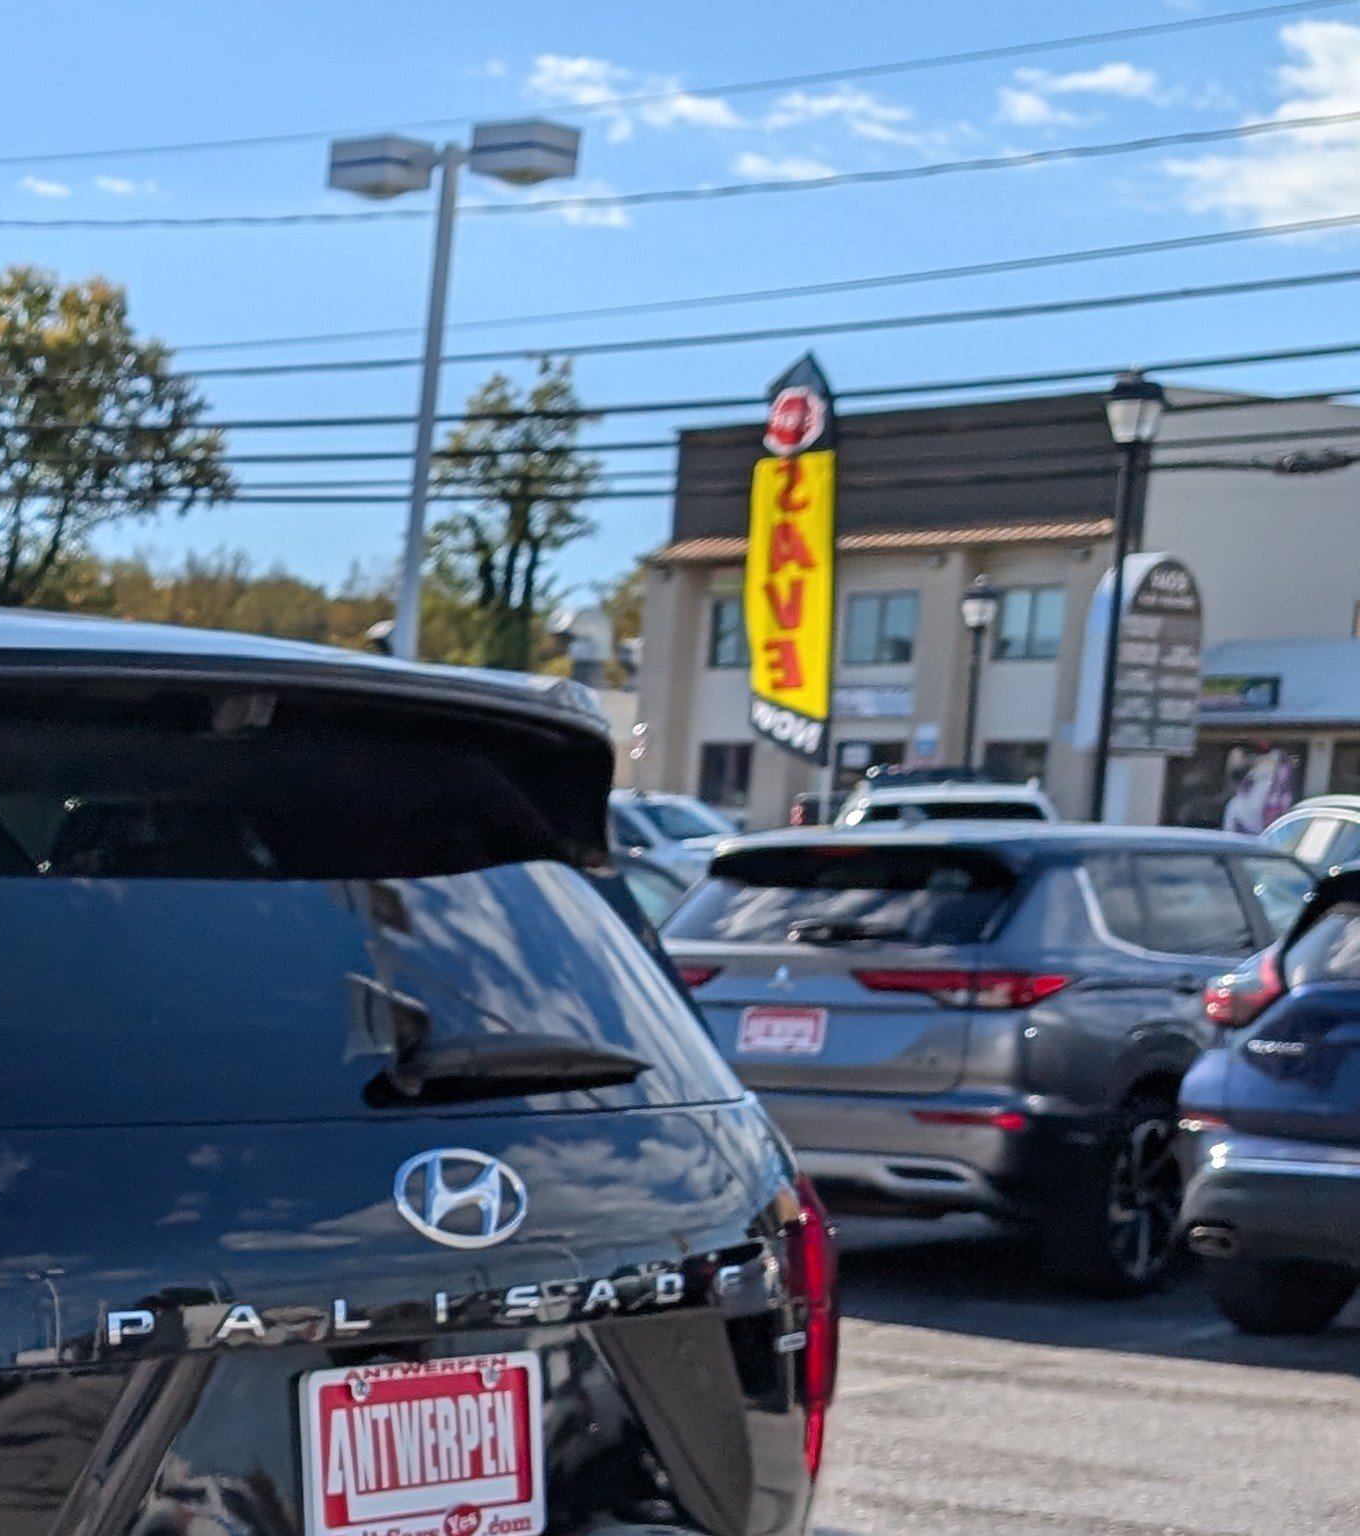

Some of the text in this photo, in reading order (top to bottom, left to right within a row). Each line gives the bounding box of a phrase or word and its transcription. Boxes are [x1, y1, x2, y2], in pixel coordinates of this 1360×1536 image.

[107, 1263, 743, 1346] PALISADE
[345, 1357, 508, 1380] ANTWERPEN
[327, 1391, 516, 1495] ANTWERPEN
[446, 1513, 479, 1535] Yes
